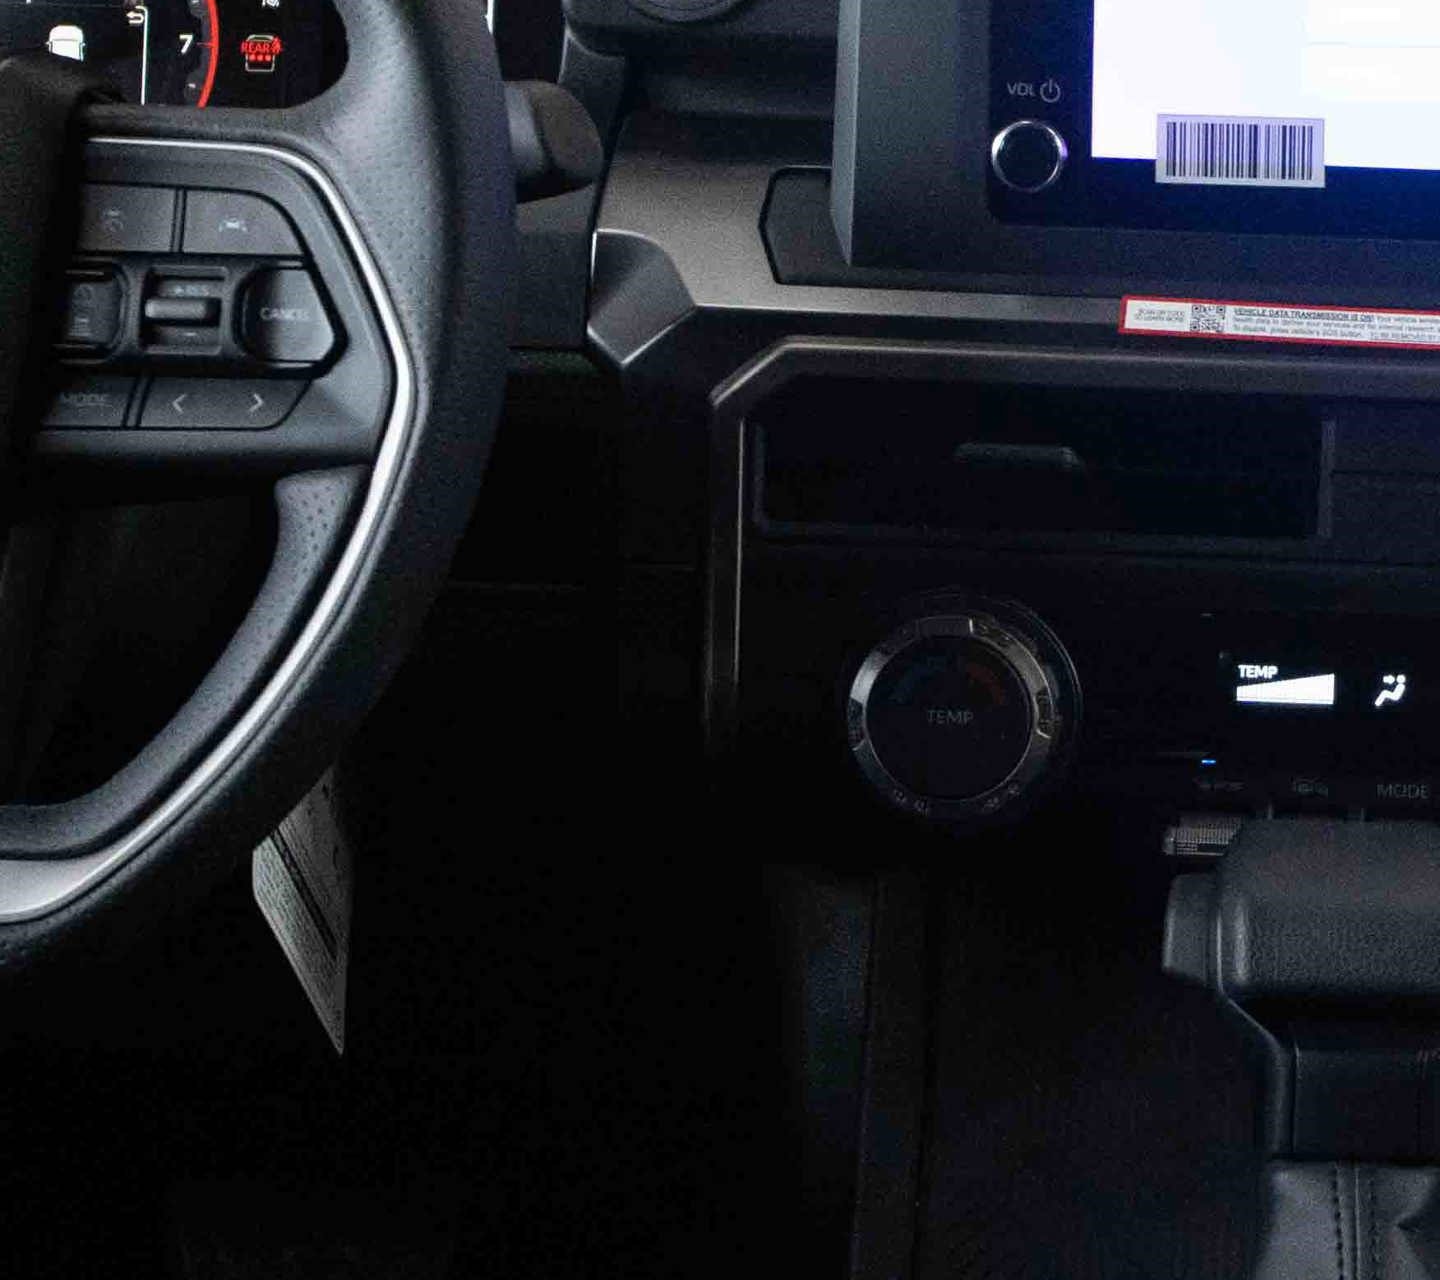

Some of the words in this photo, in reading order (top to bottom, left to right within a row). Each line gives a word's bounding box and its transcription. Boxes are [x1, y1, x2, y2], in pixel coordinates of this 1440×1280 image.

[178, 33, 195, 55] 7
[1006, 81, 1036, 97] VOL
[1237, 663, 1279, 679] TEMP
[927, 710, 975, 726] TEMP
[1375, 783, 1430, 800] MODE
